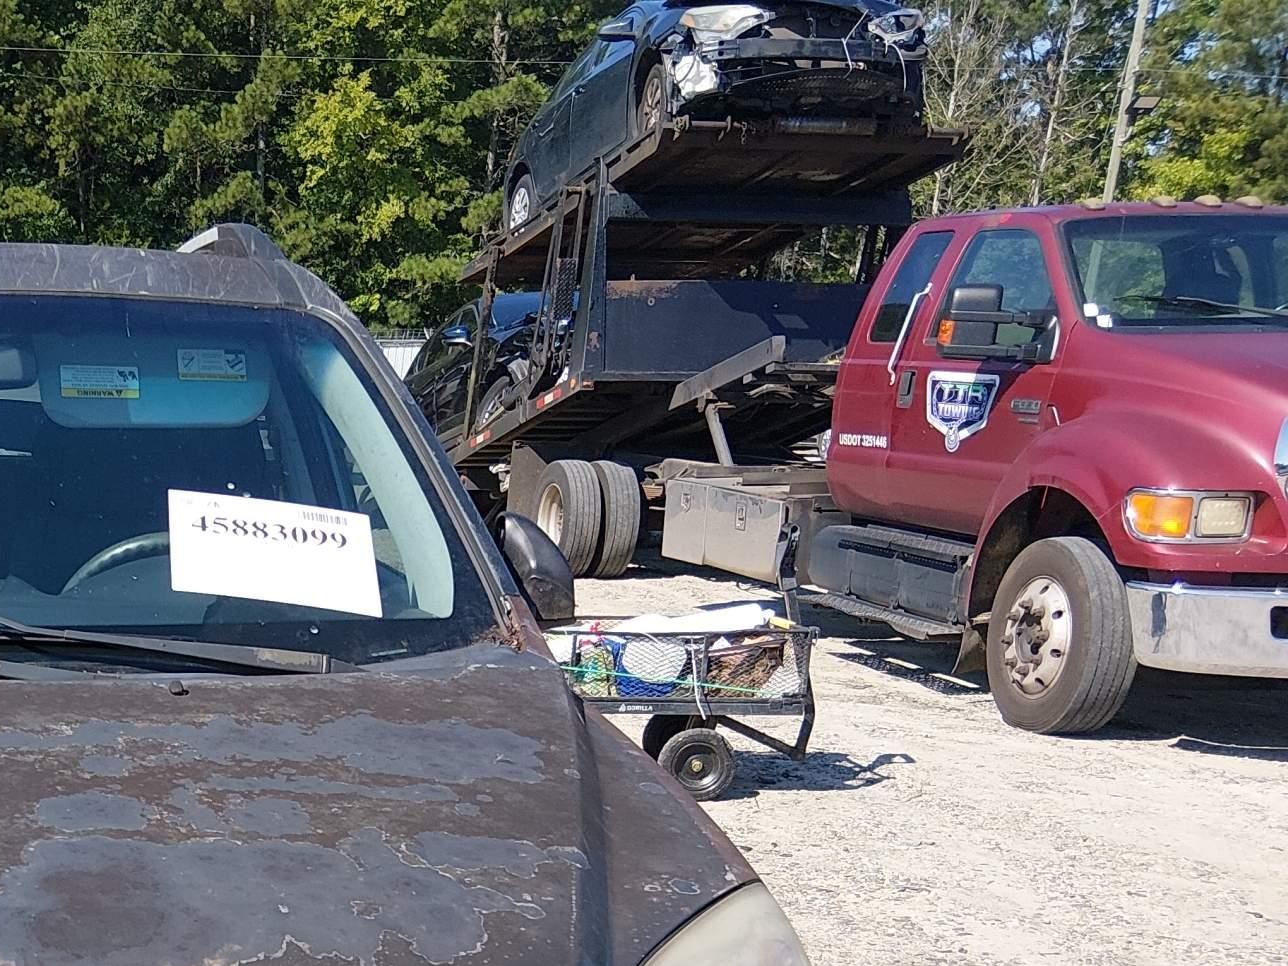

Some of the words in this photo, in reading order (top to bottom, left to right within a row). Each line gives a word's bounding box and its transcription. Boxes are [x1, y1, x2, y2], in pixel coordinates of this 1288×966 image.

[937, 403, 980, 418] TOWING
[839, 432, 862, 447] USDOT
[191, 515, 348, 549] 45883099
